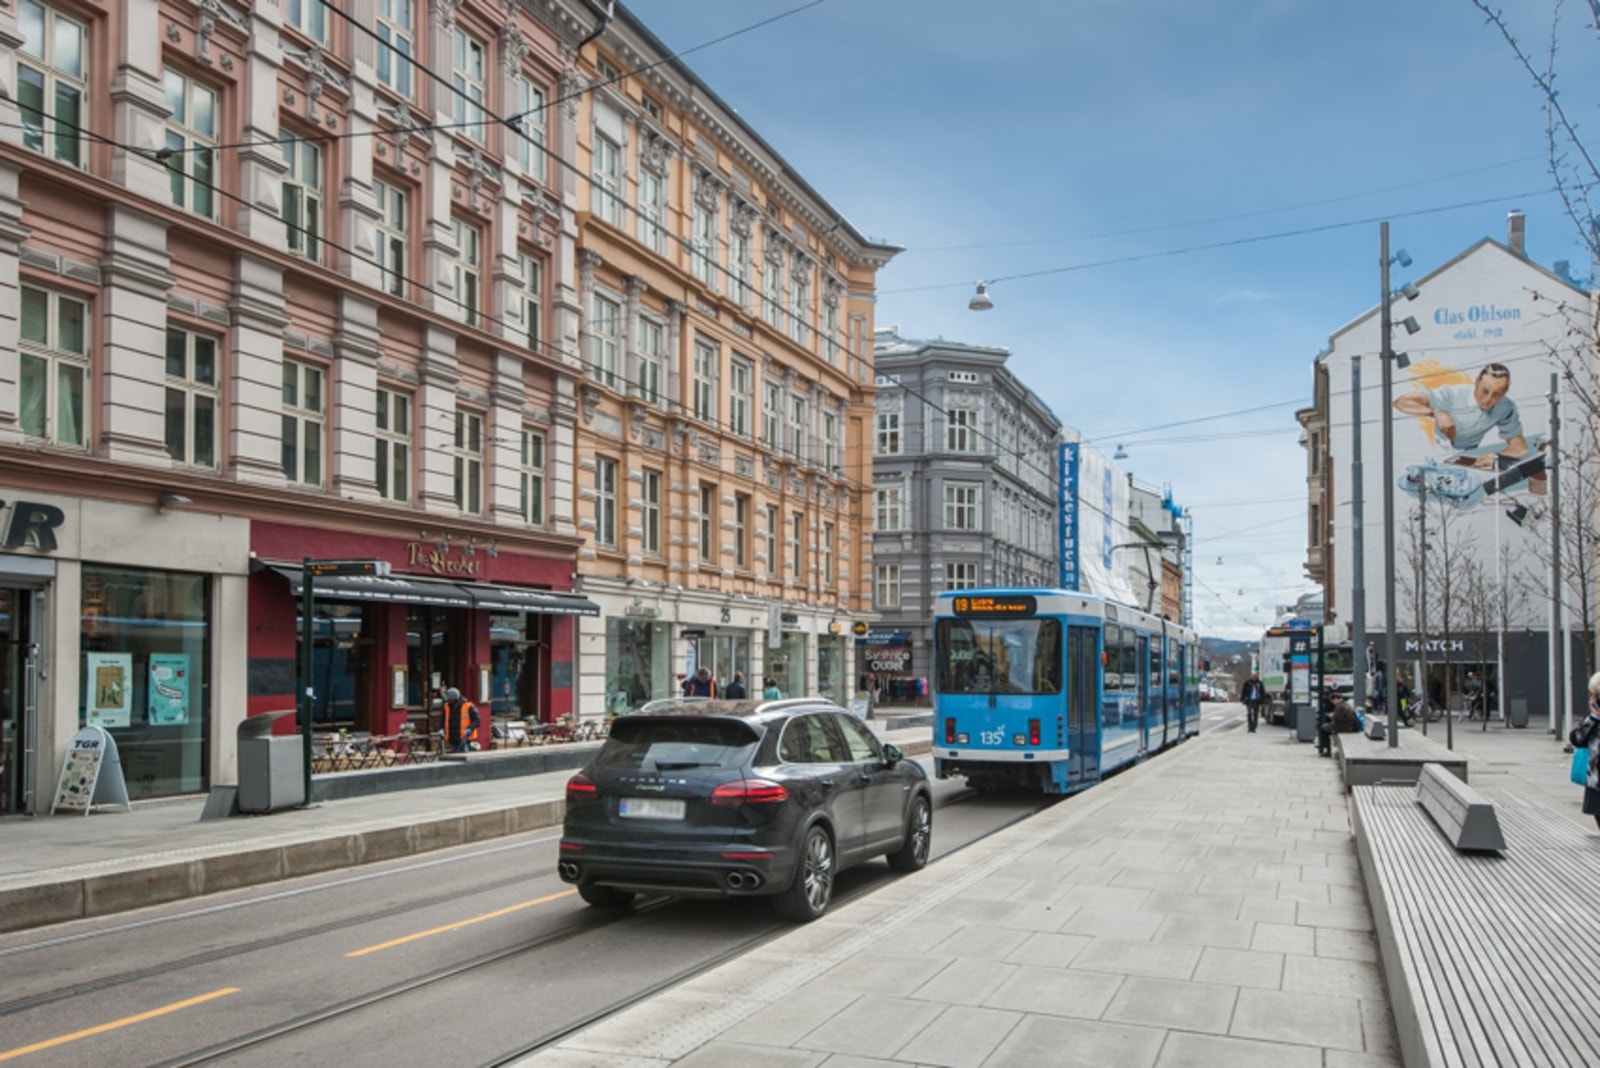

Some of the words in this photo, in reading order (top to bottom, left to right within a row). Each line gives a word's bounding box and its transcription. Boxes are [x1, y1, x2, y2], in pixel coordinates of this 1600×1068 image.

[1434, 307, 1465, 324] Clas
[1467, 304, 1521, 322] Ohlson
[74, 739, 100, 749] TGR
[981, 731, 1002, 745] 135
